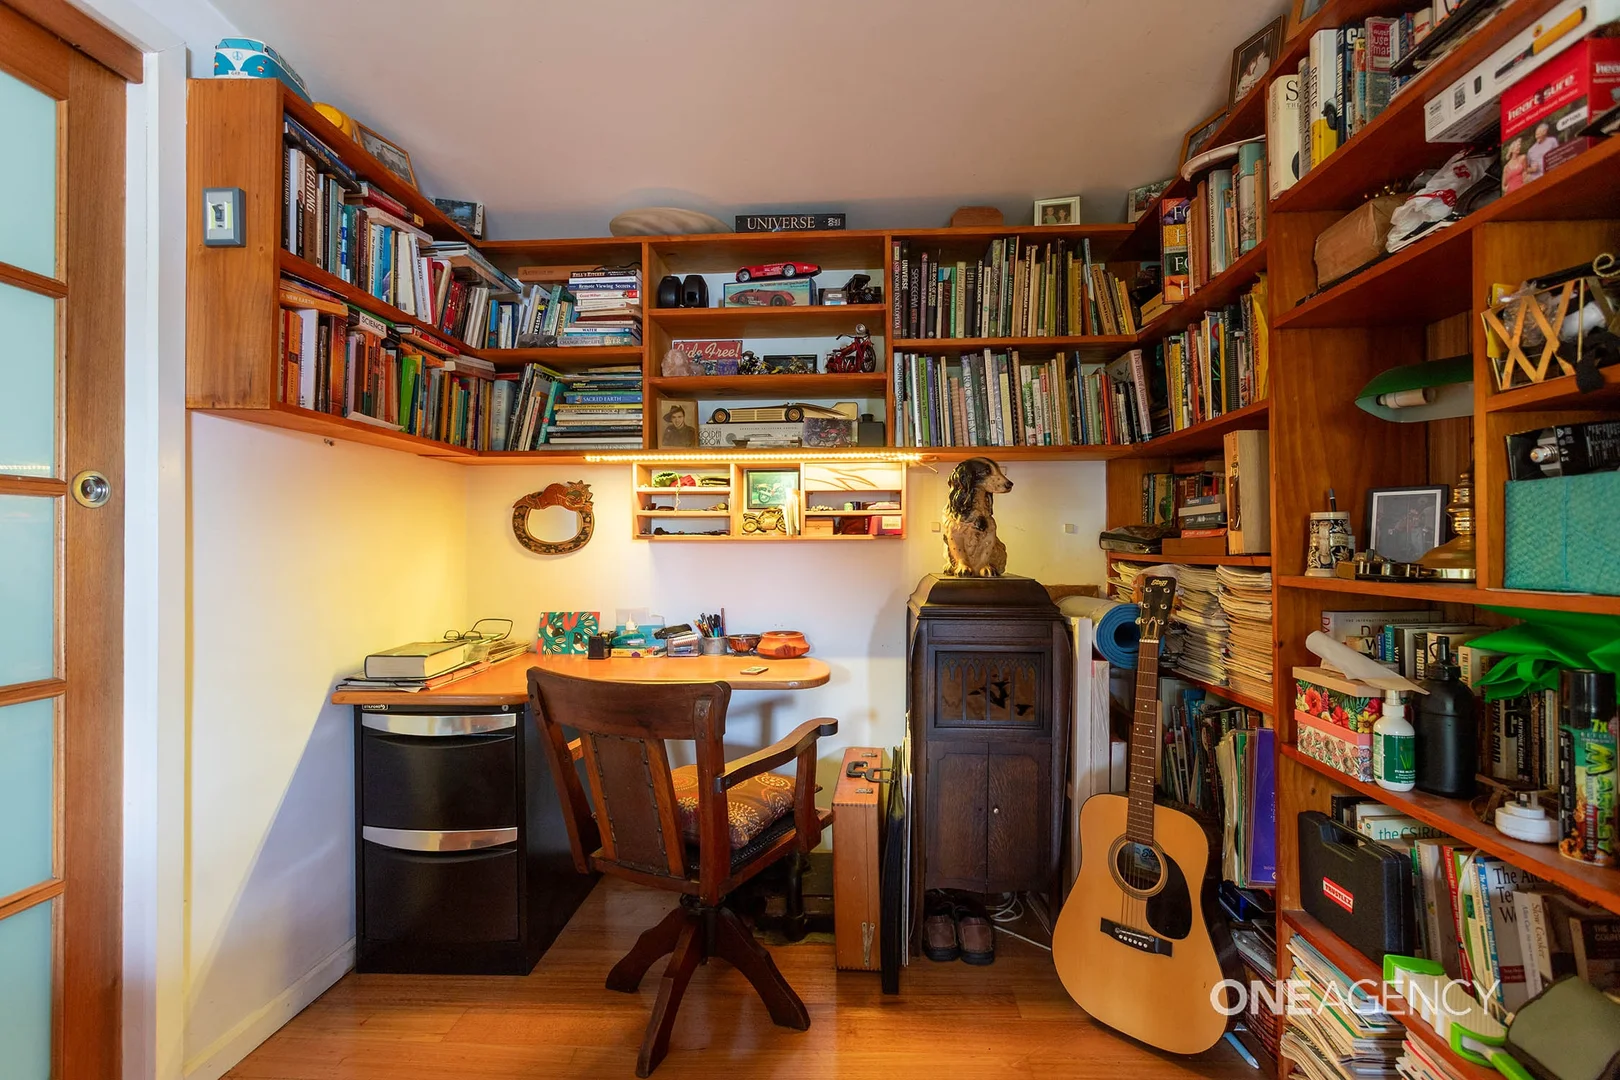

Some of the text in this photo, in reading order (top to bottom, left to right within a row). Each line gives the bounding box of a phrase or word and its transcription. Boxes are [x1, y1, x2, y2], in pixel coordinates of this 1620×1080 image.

[1508, 74, 1574, 121] heart sure
[306, 164, 316, 215] KEATING
[747, 216, 815, 230] UNIVERSE
[362, 315, 384, 332] SCIENCE
[706, 341, 740, 359] Free!
[964, 375, 976, 433] ROCK GEM
[1139, 388, 1147, 412] Australia
[1591, 719, 1607, 733] 7x
[1379, 828, 1399, 840] the
[1494, 868, 1517, 885] The
[1483, 908, 1492, 929] Technique
[1532, 903, 1546, 958] Slow Cooker
